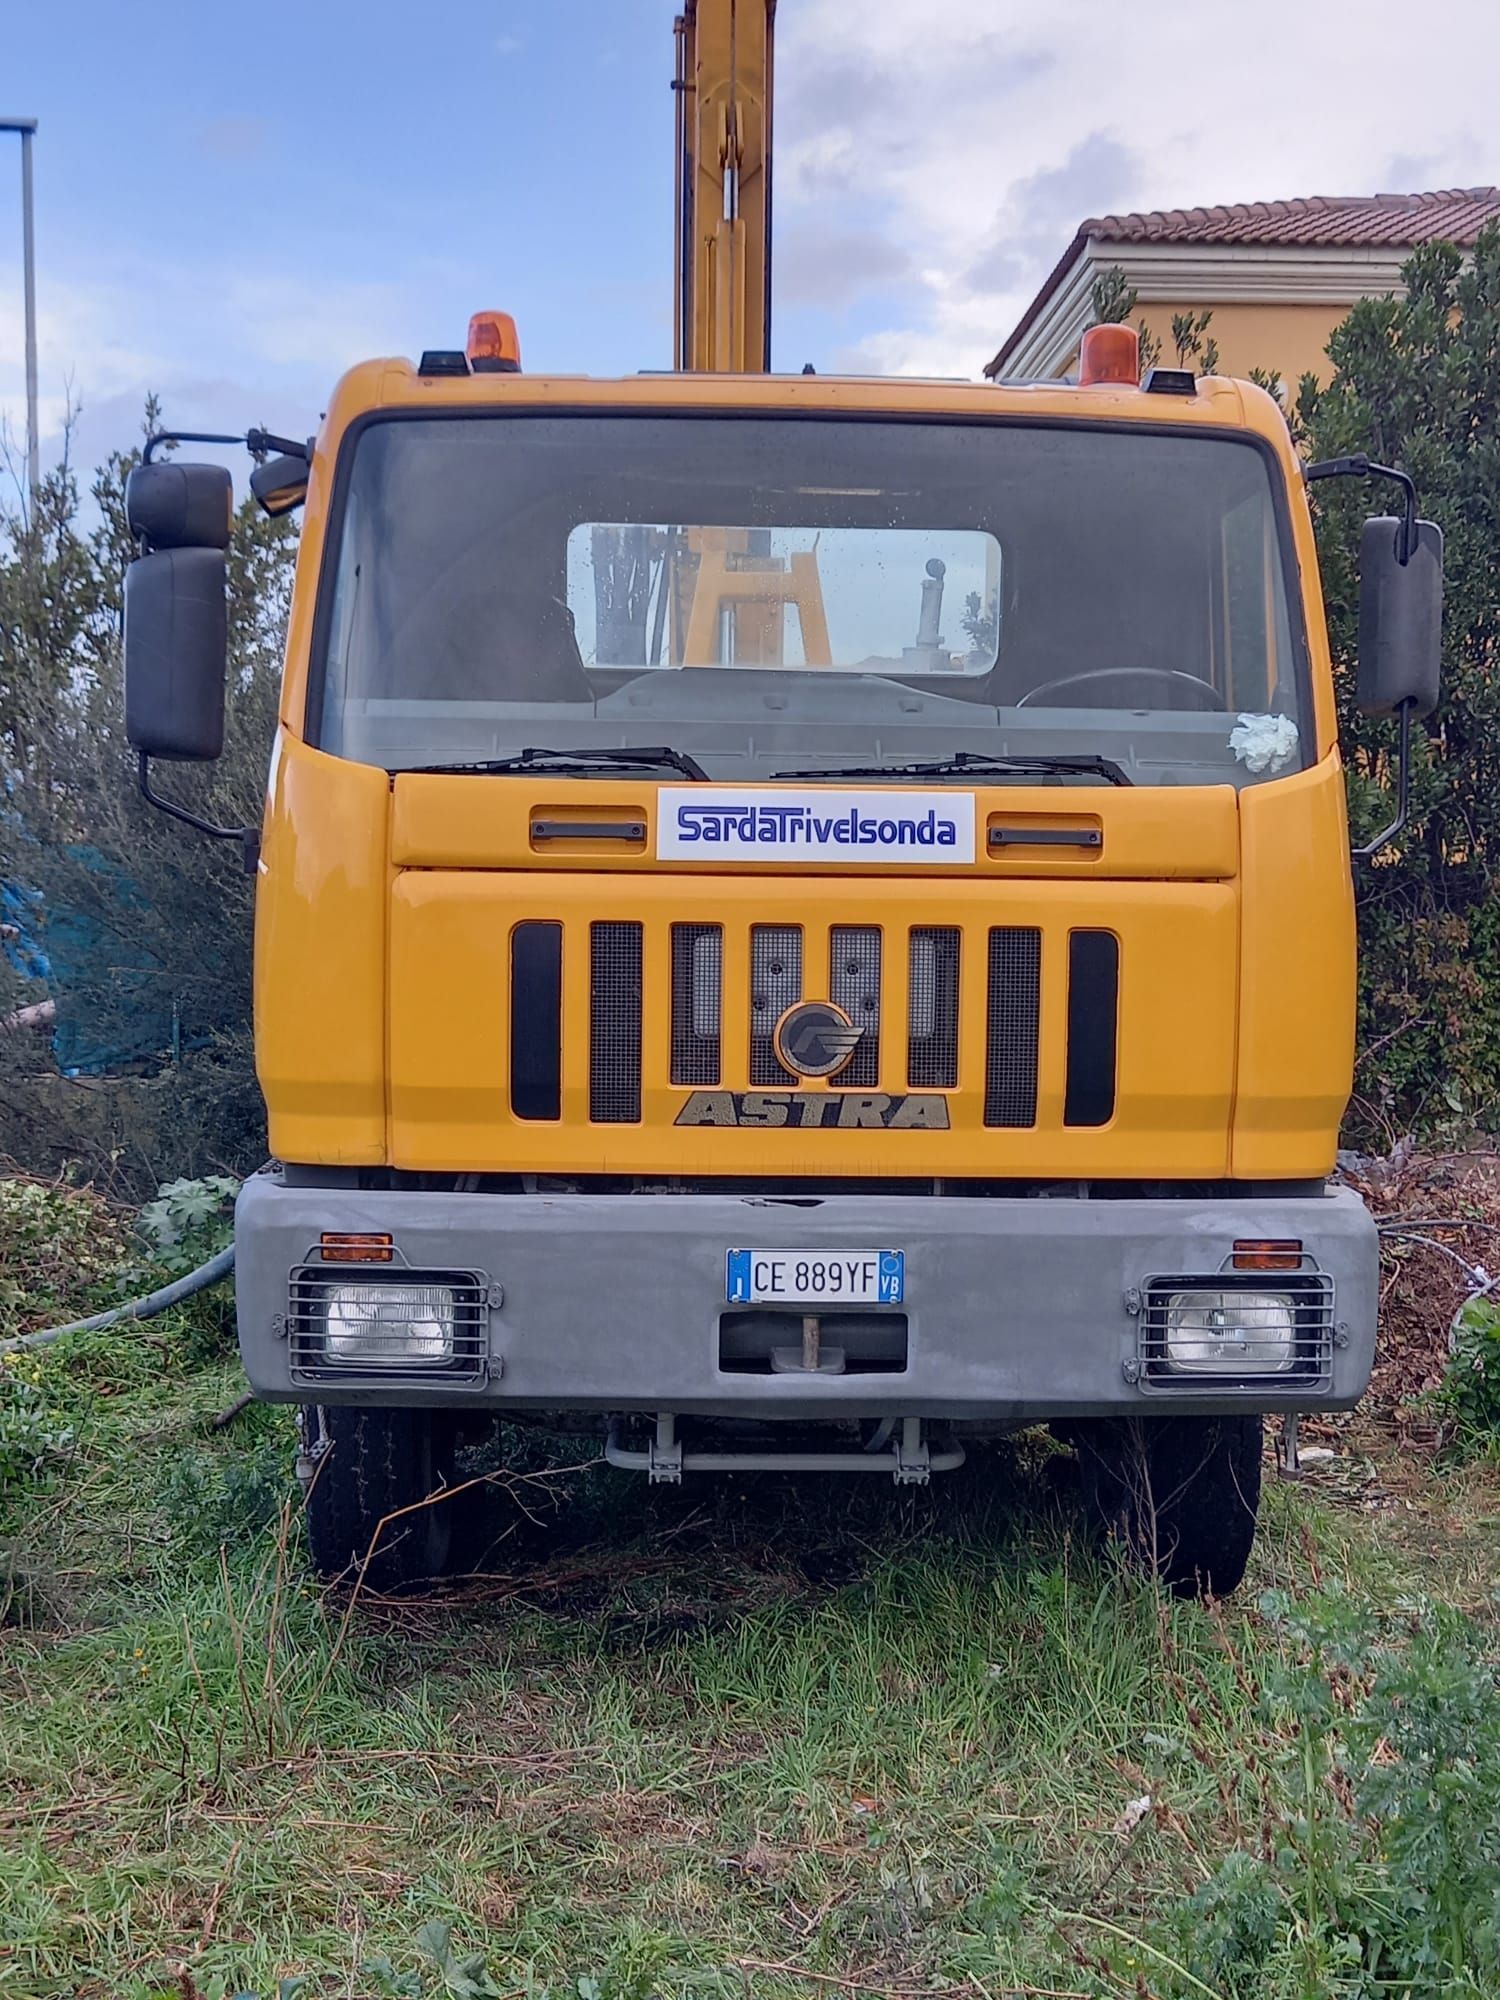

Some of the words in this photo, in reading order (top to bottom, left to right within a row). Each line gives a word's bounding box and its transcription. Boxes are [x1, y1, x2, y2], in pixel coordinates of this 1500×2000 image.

[678, 806, 956, 845] SardaTrivelsonda
[673, 1091, 951, 1129] ASTRA
[754, 1262, 786, 1292] CE
[795, 1262, 877, 1293] 889YF
[881, 1275, 900, 1295] VB
